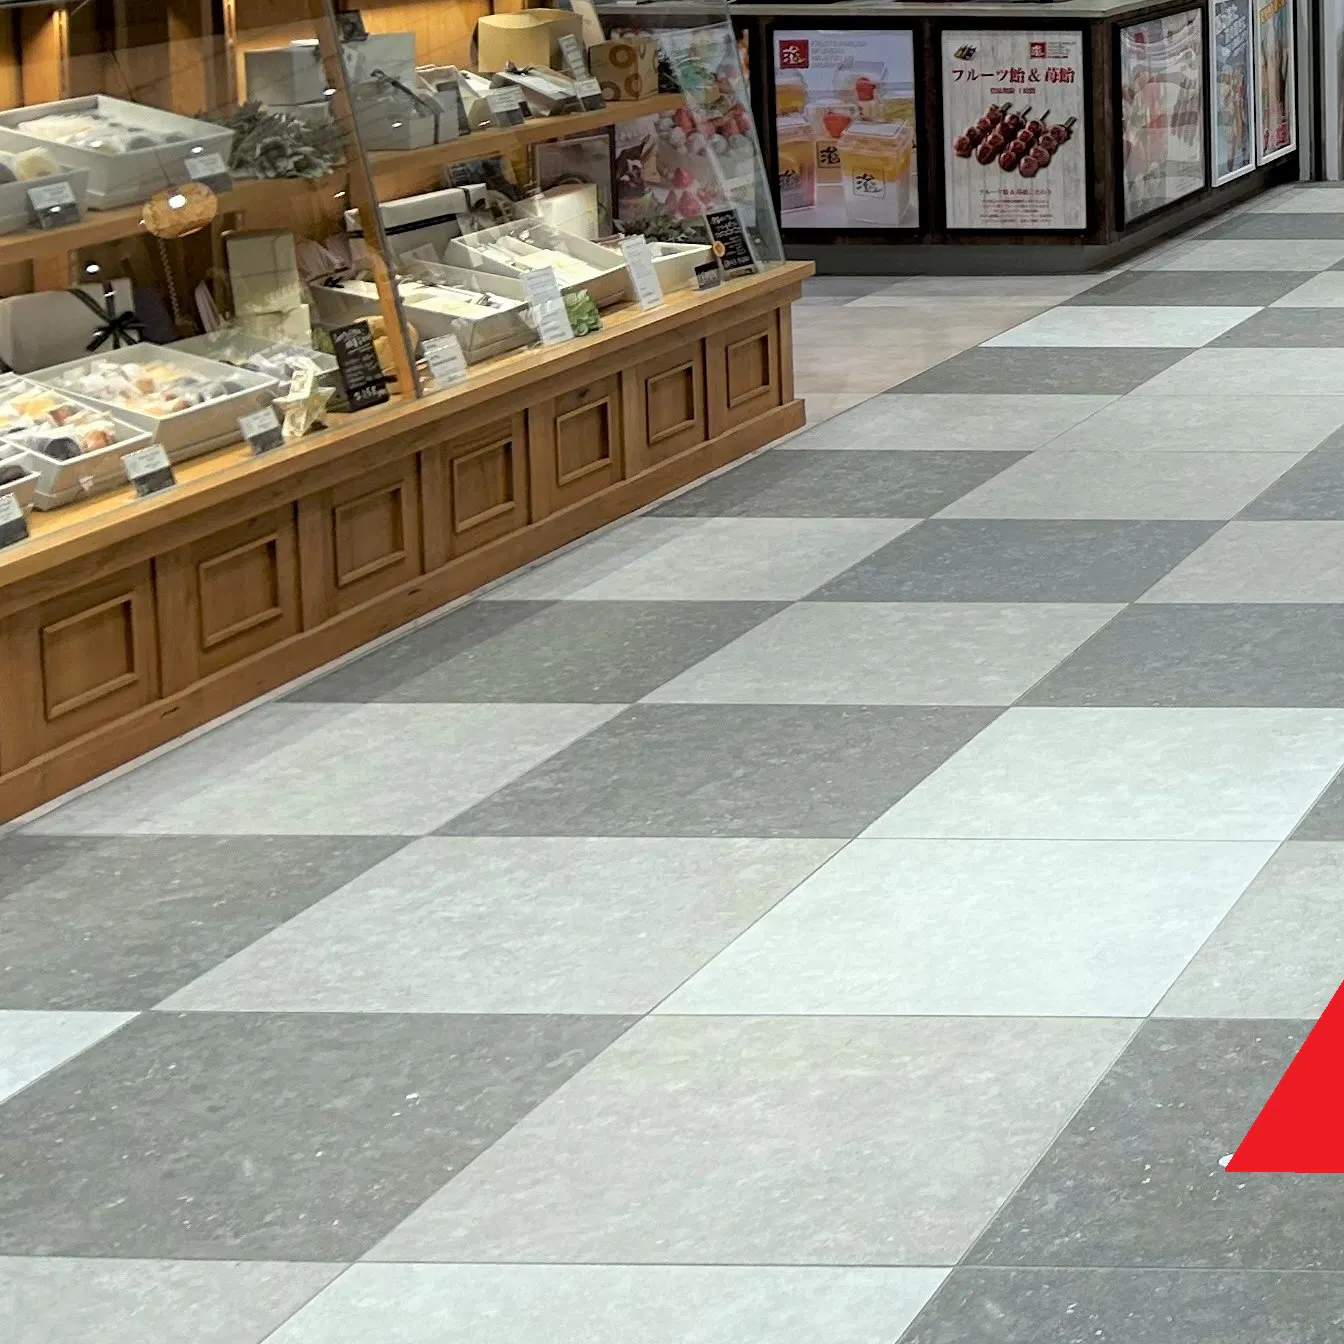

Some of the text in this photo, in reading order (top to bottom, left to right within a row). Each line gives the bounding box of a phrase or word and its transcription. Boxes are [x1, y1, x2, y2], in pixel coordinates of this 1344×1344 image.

[952, 67, 1025, 83] フルーツ飴
[1029, 68, 1040, 82] &
